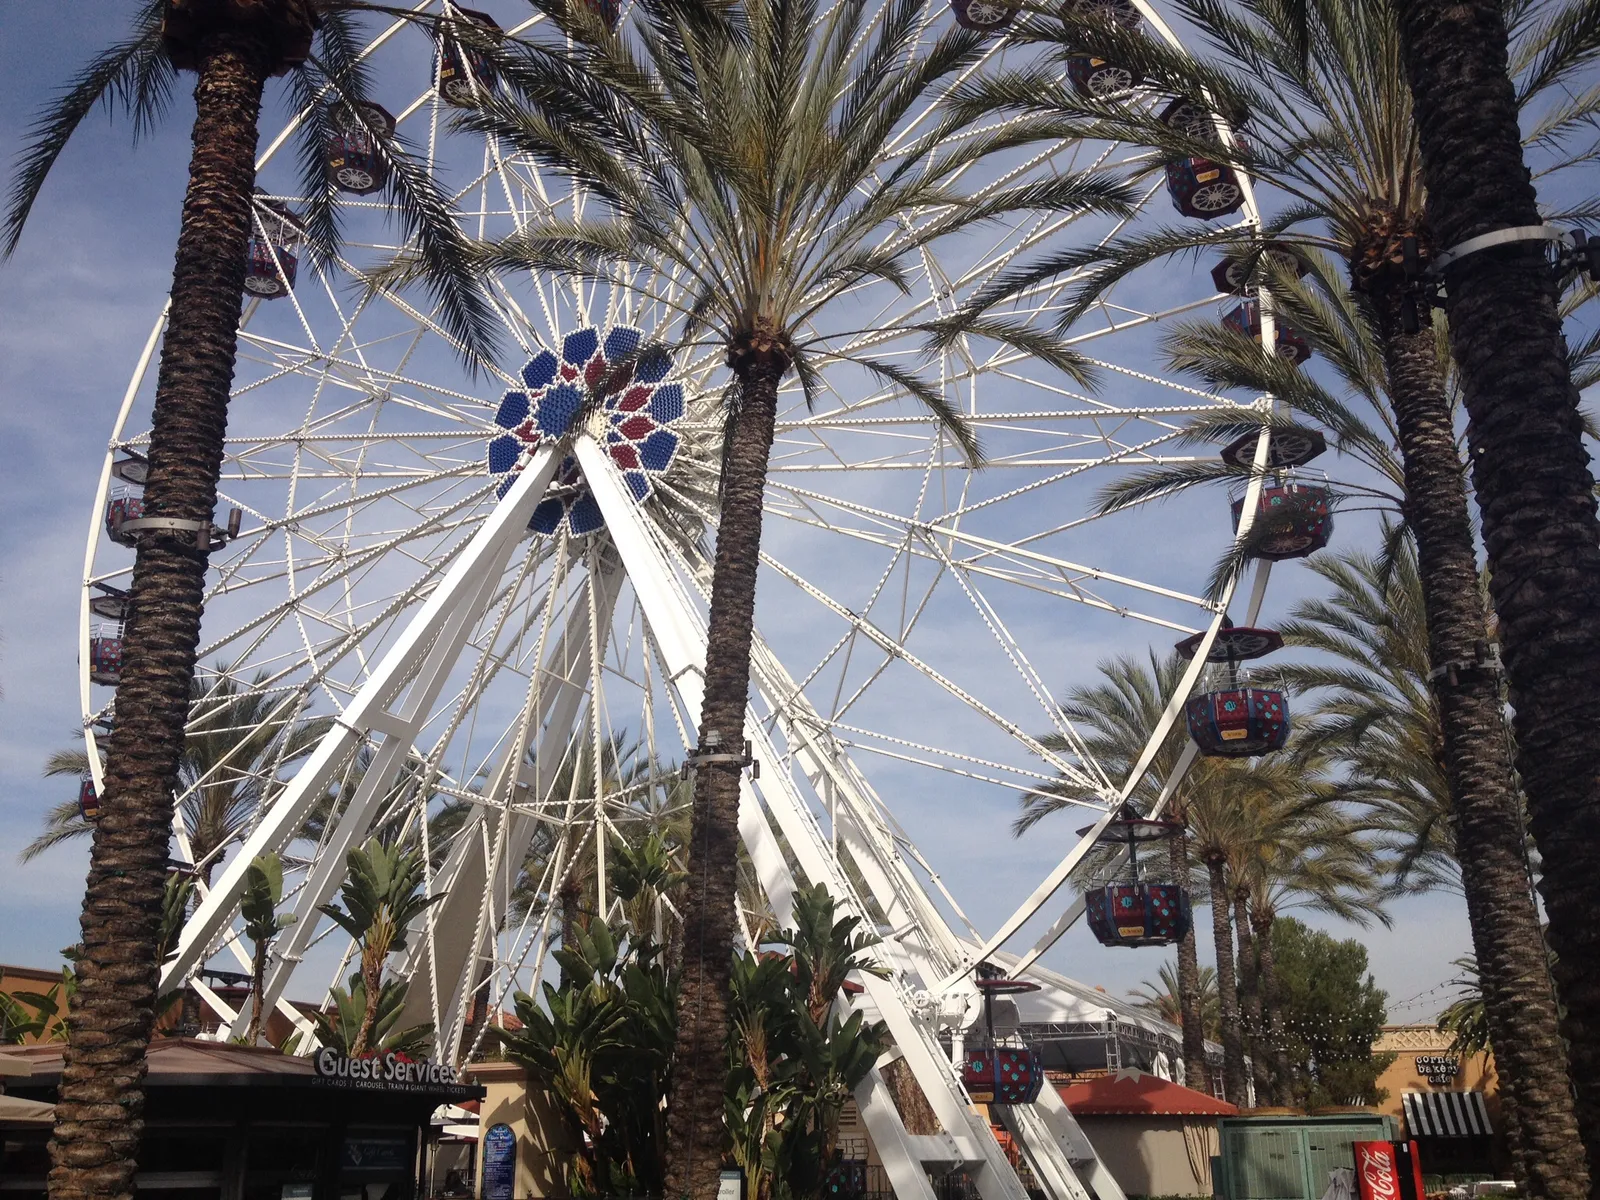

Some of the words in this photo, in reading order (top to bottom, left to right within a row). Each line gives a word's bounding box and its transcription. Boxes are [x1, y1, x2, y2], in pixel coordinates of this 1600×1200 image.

[318, 1046, 381, 1079] Guest
[384, 1052, 457, 1085] Services
[1417, 1064, 1459, 1075] bakery
[327, 1079, 347, 1087] CARDS
[410, 1084, 427, 1092] GIANT
[446, 1086, 467, 1094] TICKETS
